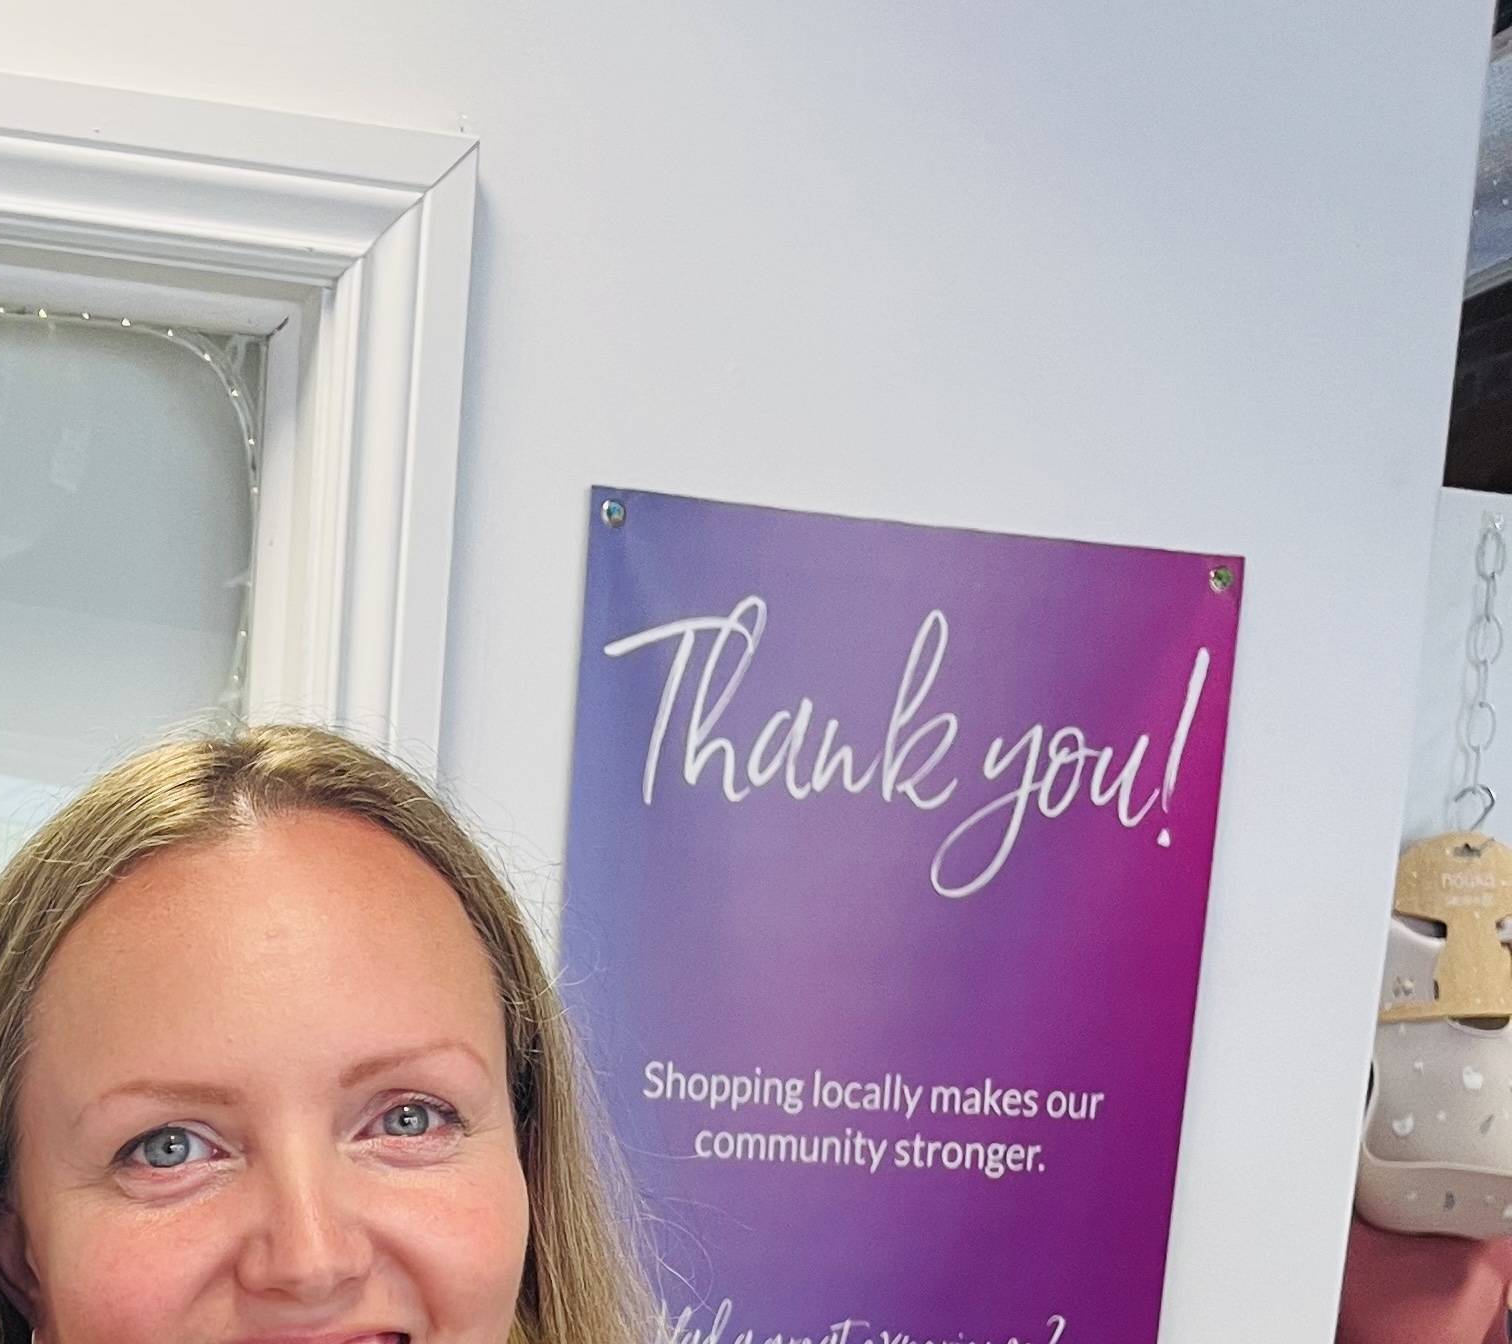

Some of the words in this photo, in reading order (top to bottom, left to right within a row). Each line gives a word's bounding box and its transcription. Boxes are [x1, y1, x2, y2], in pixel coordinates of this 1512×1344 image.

[603, 594, 961, 810] Thank
[929, 645, 1211, 899] you!
[642, 1060, 803, 1115] Shopping
[811, 1069, 923, 1120] locally
[930, 1077, 1039, 1119] makes
[1045, 1088, 1105, 1120] our
[693, 1126, 889, 1174] community
[892, 1132, 1047, 1180] stronger.
